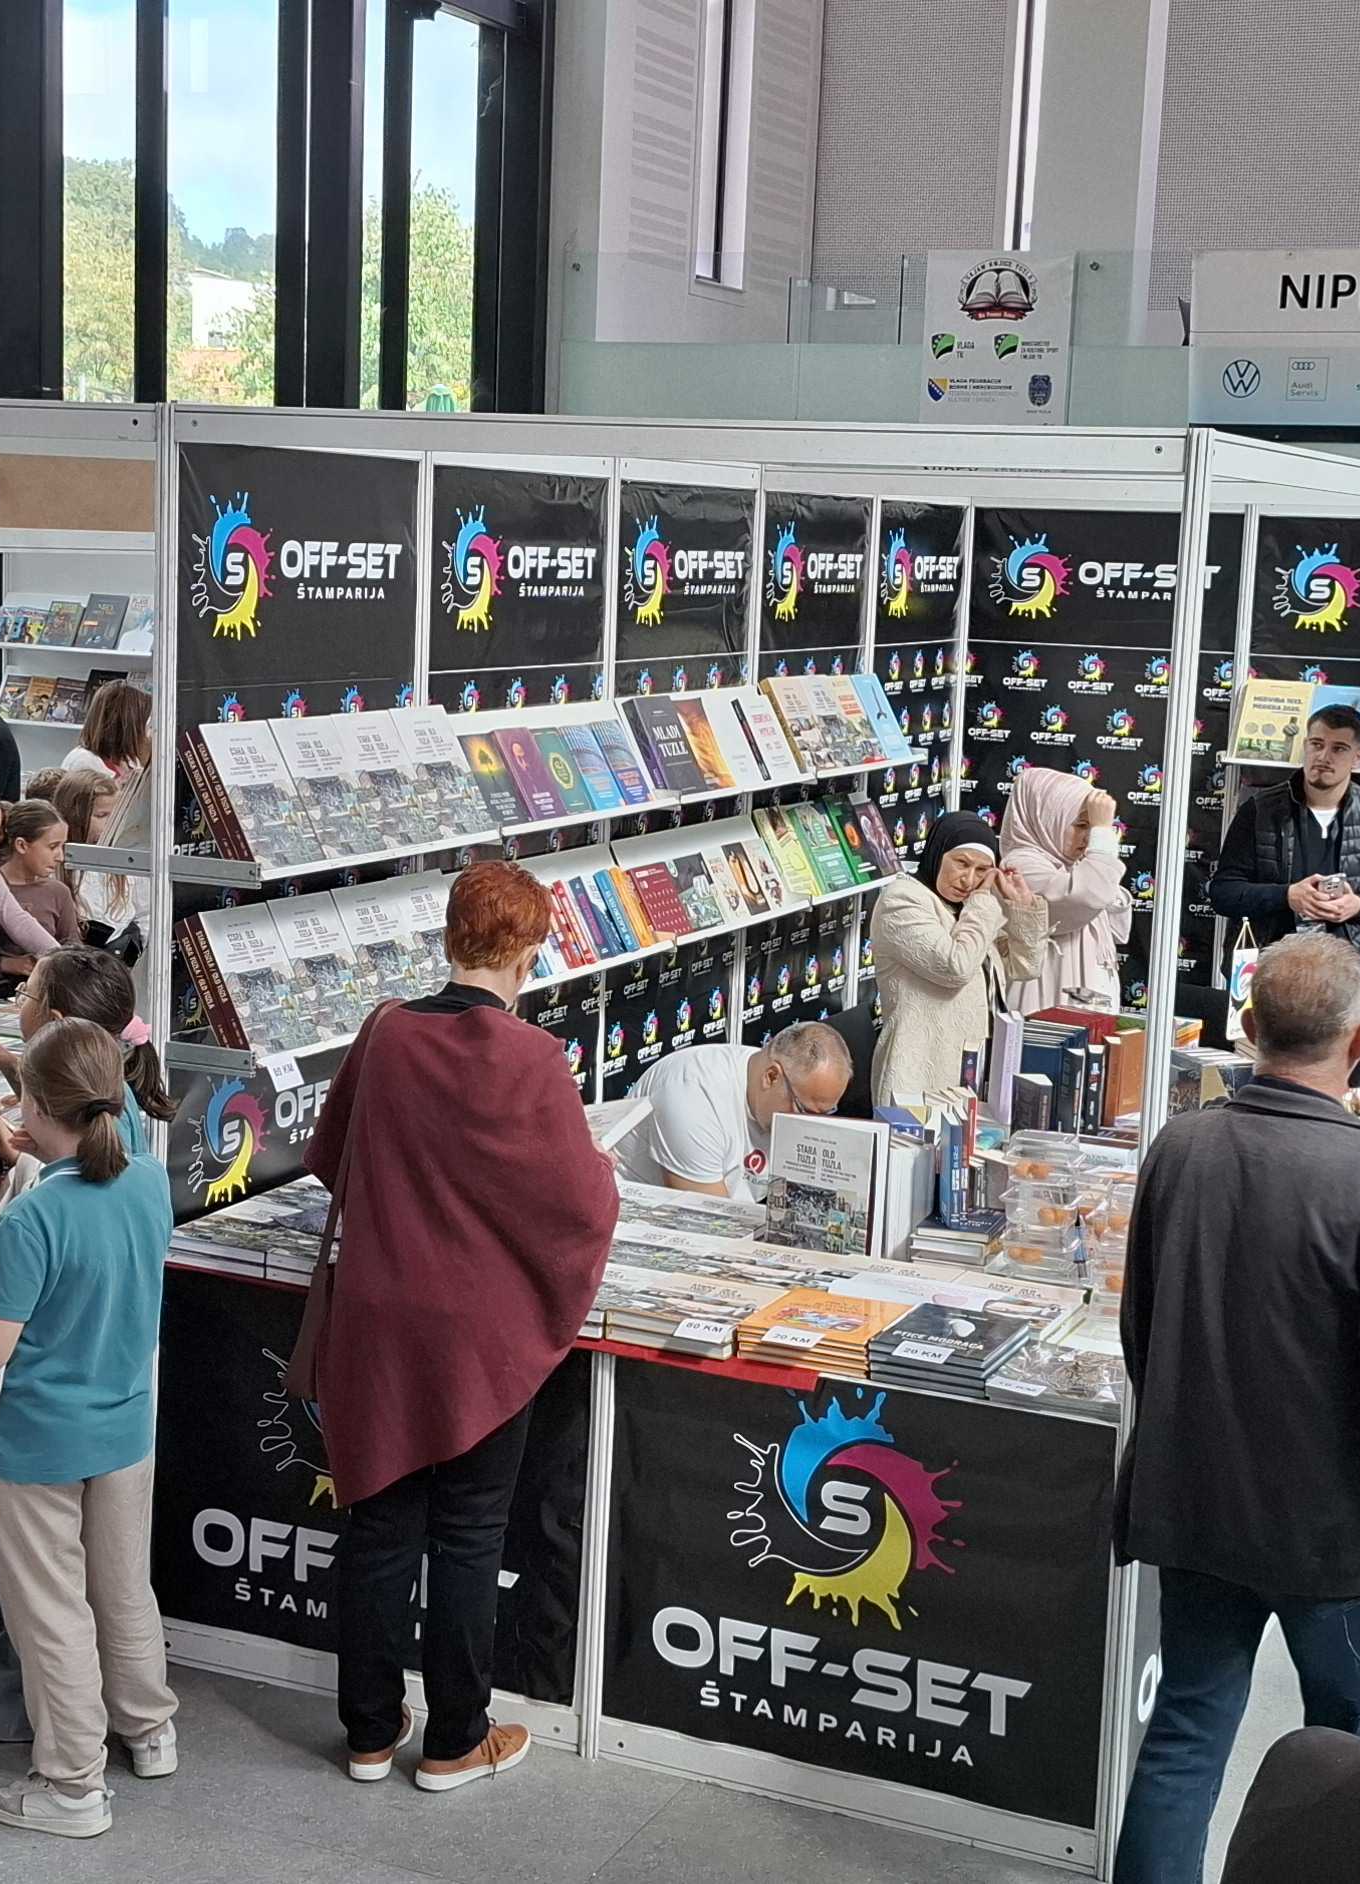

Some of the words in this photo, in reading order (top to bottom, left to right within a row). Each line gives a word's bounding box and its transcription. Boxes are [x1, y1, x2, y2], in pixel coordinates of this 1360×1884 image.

[1291, 381, 1314, 390] Audi
[280, 540, 403, 580] OFF-SET
[507, 545, 597, 582] OFF-SET
[674, 549, 745, 581] OFF-SET
[807, 553, 864, 580] OFF-SET
[914, 555, 960, 581] OFF-SET
[1078, 561, 1222, 590] OFF-ST
[296, 582, 386, 601] ŠTAMPARIJA
[518, 582, 585, 598] ŠTAMPARIJA
[1096, 587, 1172, 601] ŠTAMPAR
[1003, 676, 1048, 688] OFF-SET
[1068, 681, 1115, 692] OFF-SET
[653, 724, 681, 742] MLADI
[968, 728, 1011, 738] OFF-SET
[1030, 731, 1077, 743] OFF-SET
[658, 740, 689, 757] TUZLE
[1096, 736, 1143, 747] OFF-SET
[703, 1325, 724, 1334] KM
[892, 1329, 927, 1342] PTICE
[790, 1336, 812, 1344] KM
[903, 1348, 919, 1357] 20
[921, 1351, 943, 1359] KM
[652, 1606, 1033, 1737] OFF-SET
[700, 1680, 975, 1768] ŠTAMPARIJA
